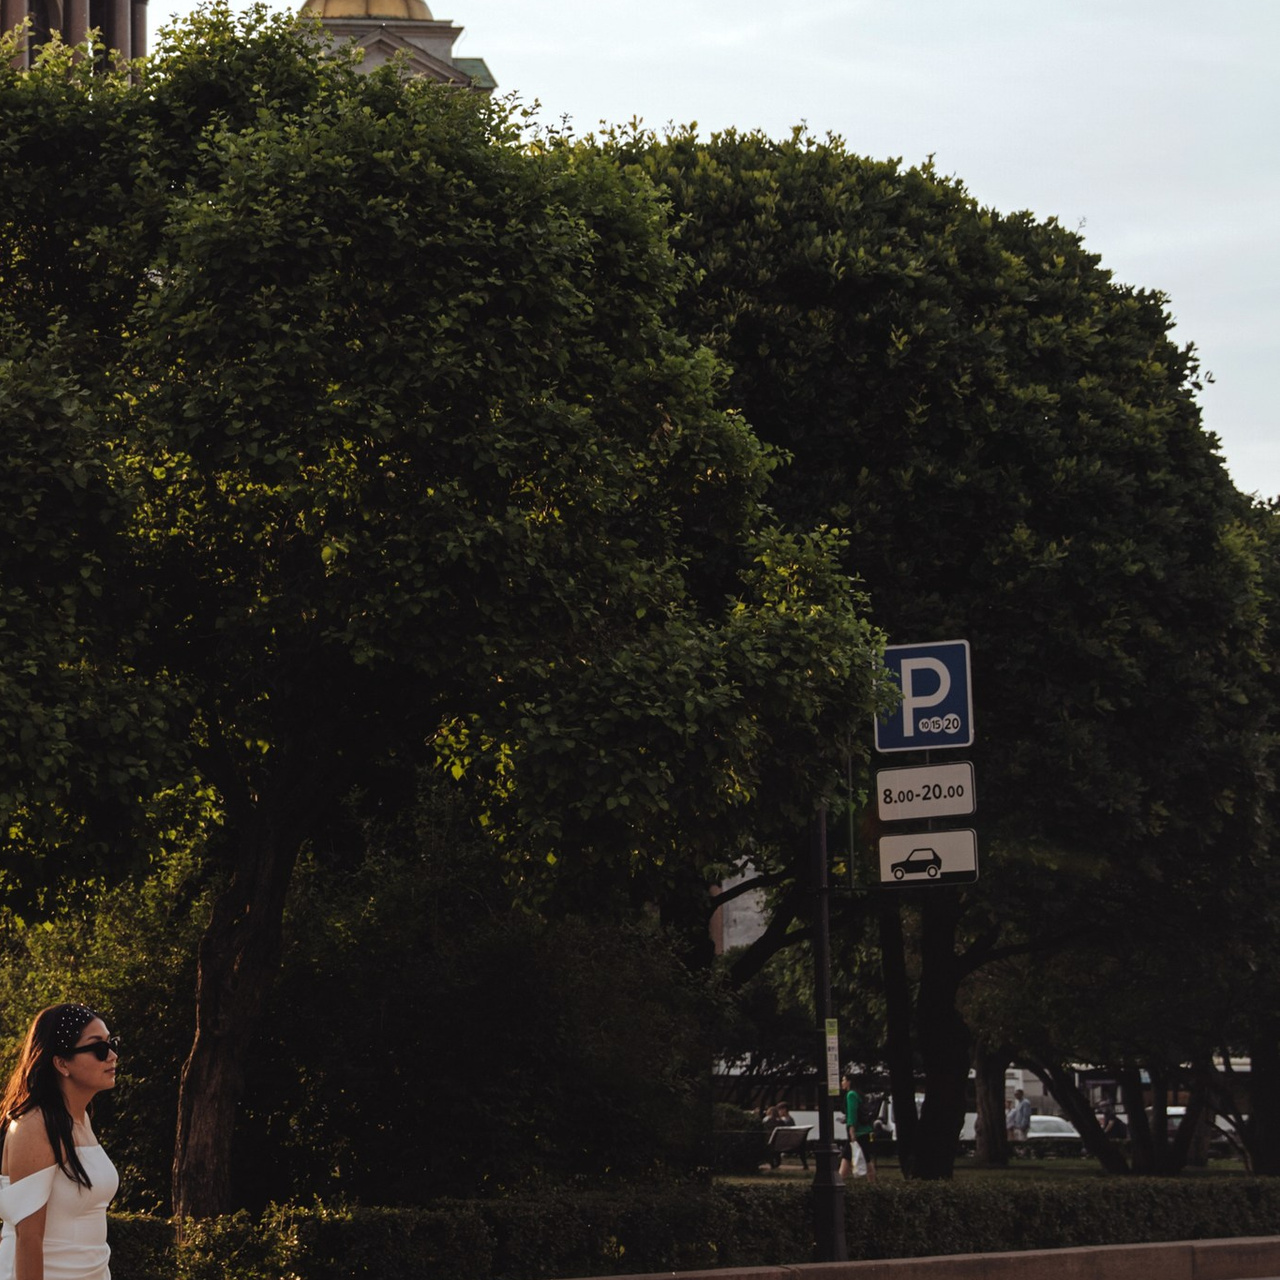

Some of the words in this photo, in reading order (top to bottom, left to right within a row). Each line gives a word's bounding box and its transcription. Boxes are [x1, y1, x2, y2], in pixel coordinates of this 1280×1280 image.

[900, 657, 951, 737] P
[921, 721, 929, 729] 10
[932, 720, 941, 729] 15
[944, 717, 959, 730] 20
[883, 783, 964, 804] 8.00-20.00
